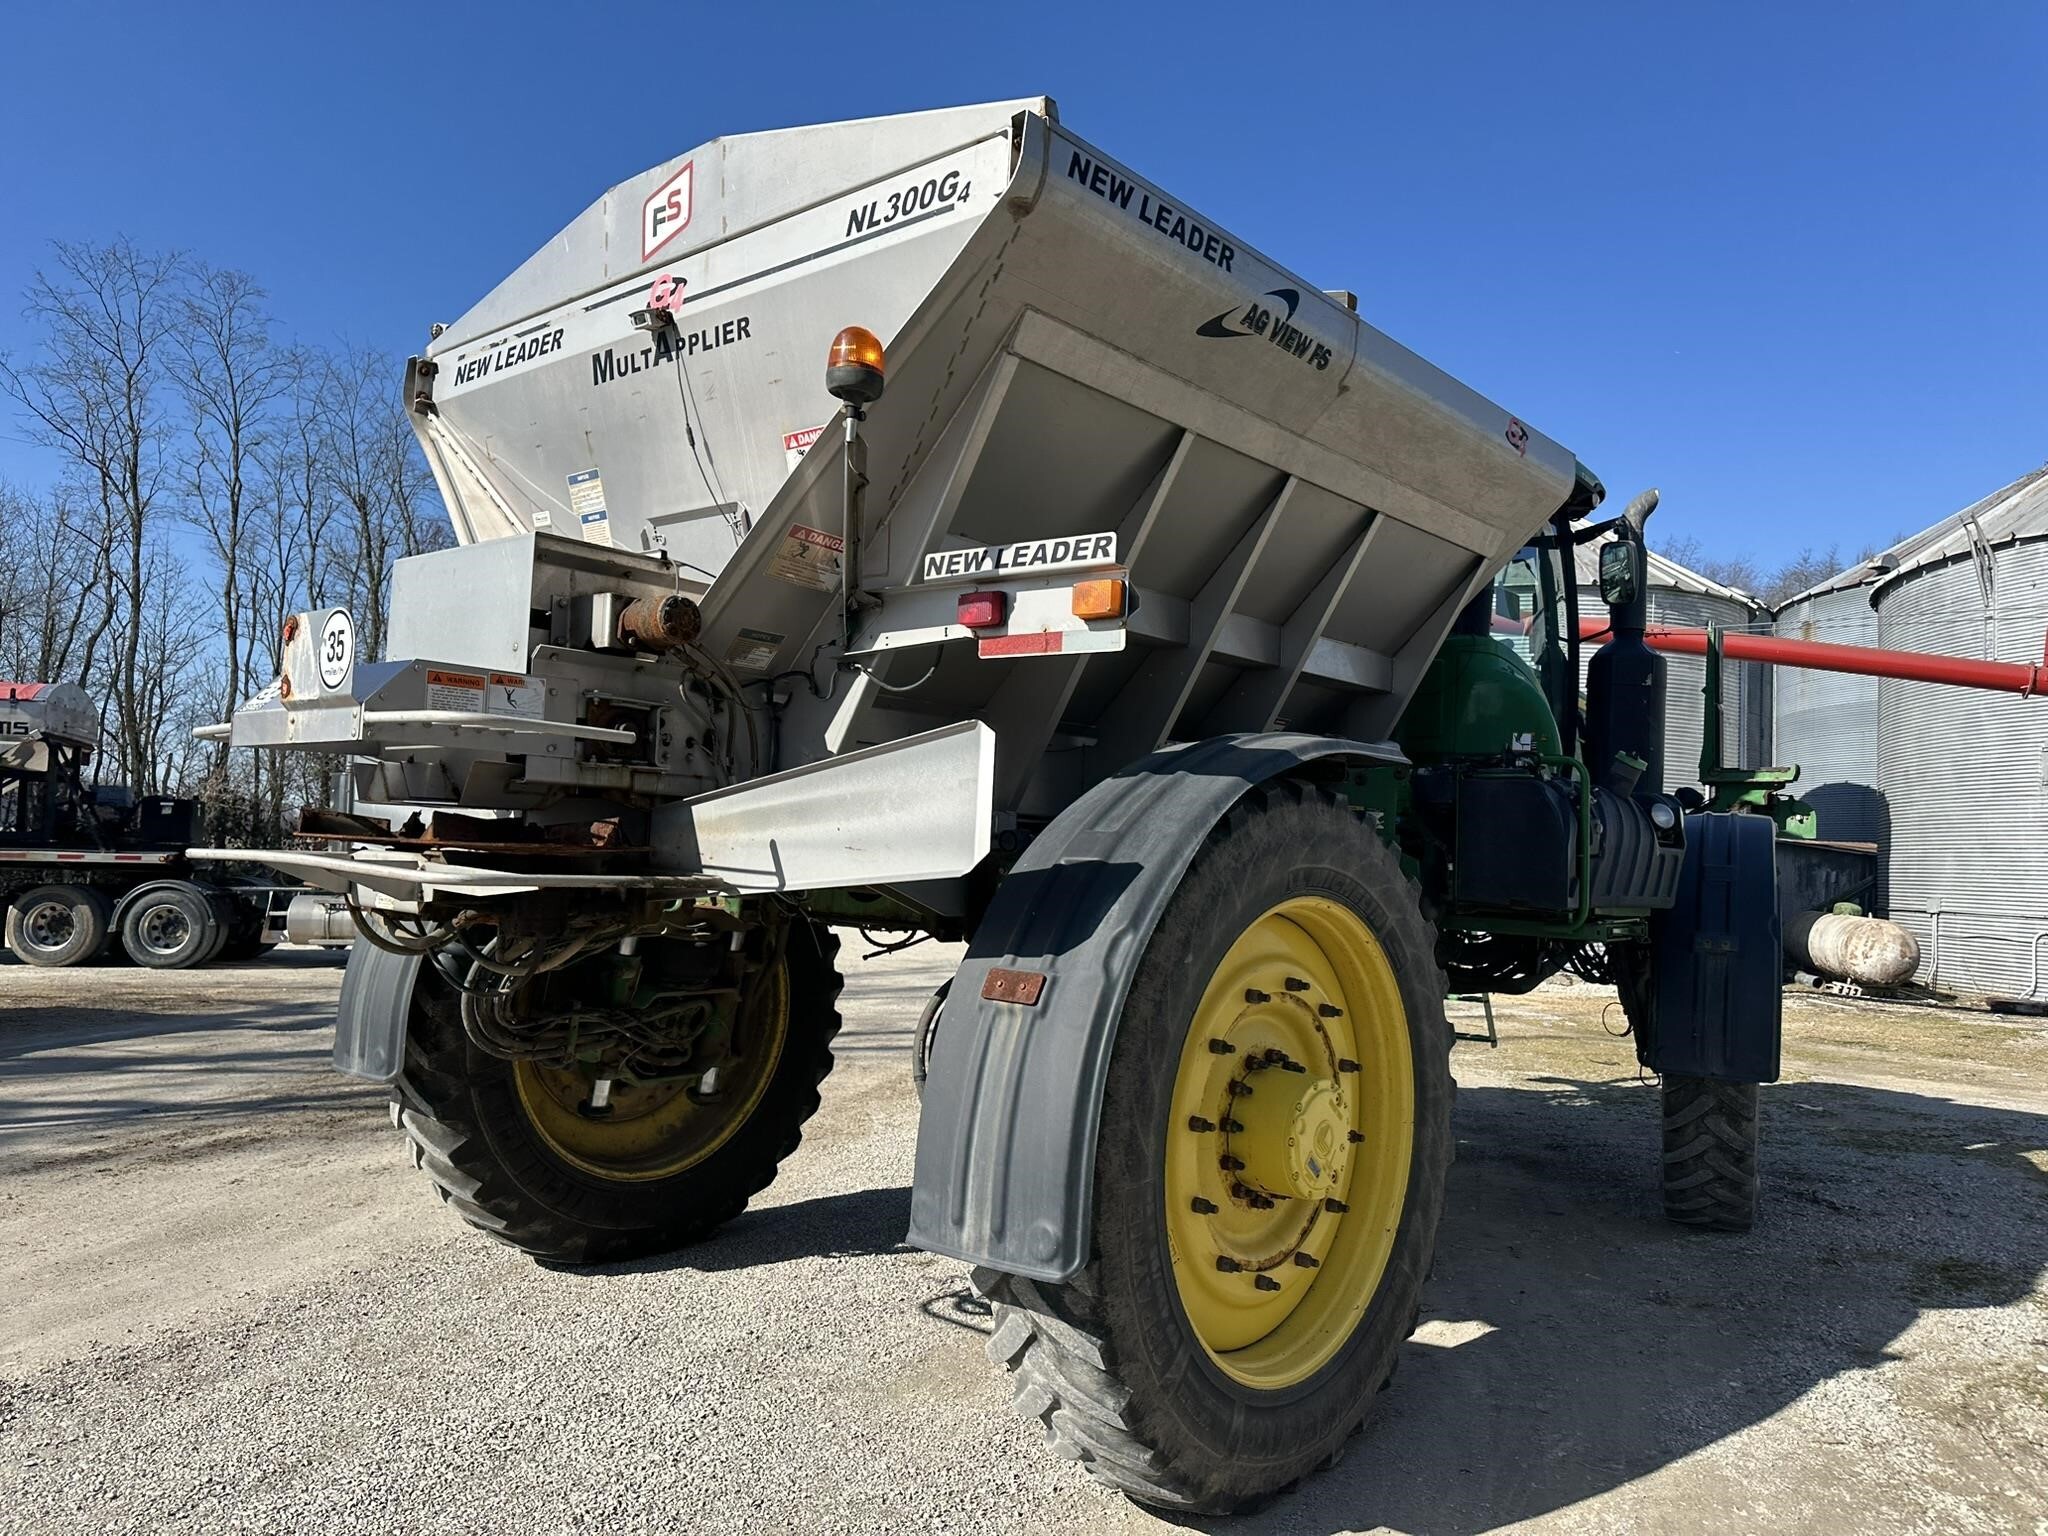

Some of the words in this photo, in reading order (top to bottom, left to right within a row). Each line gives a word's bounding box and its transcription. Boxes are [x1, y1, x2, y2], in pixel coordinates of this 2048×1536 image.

[652, 188, 682, 238] FS
[845, 170, 971, 237] NL300G4
[1067, 151, 1135, 210] NEW
[1138, 194, 1235, 273] LEADER
[454, 354, 492, 386] NEW
[494, 328, 564, 372] LEADER
[1240, 303, 1270, 336] AG
[1268, 316, 1313, 360] VIEW
[1306, 342, 1332, 371] FS
[926, 550, 988, 577] NEW
[994, 535, 1113, 569] LEADER
[327, 629, 345, 663] 35
[446, 675, 481, 687] WARNING
